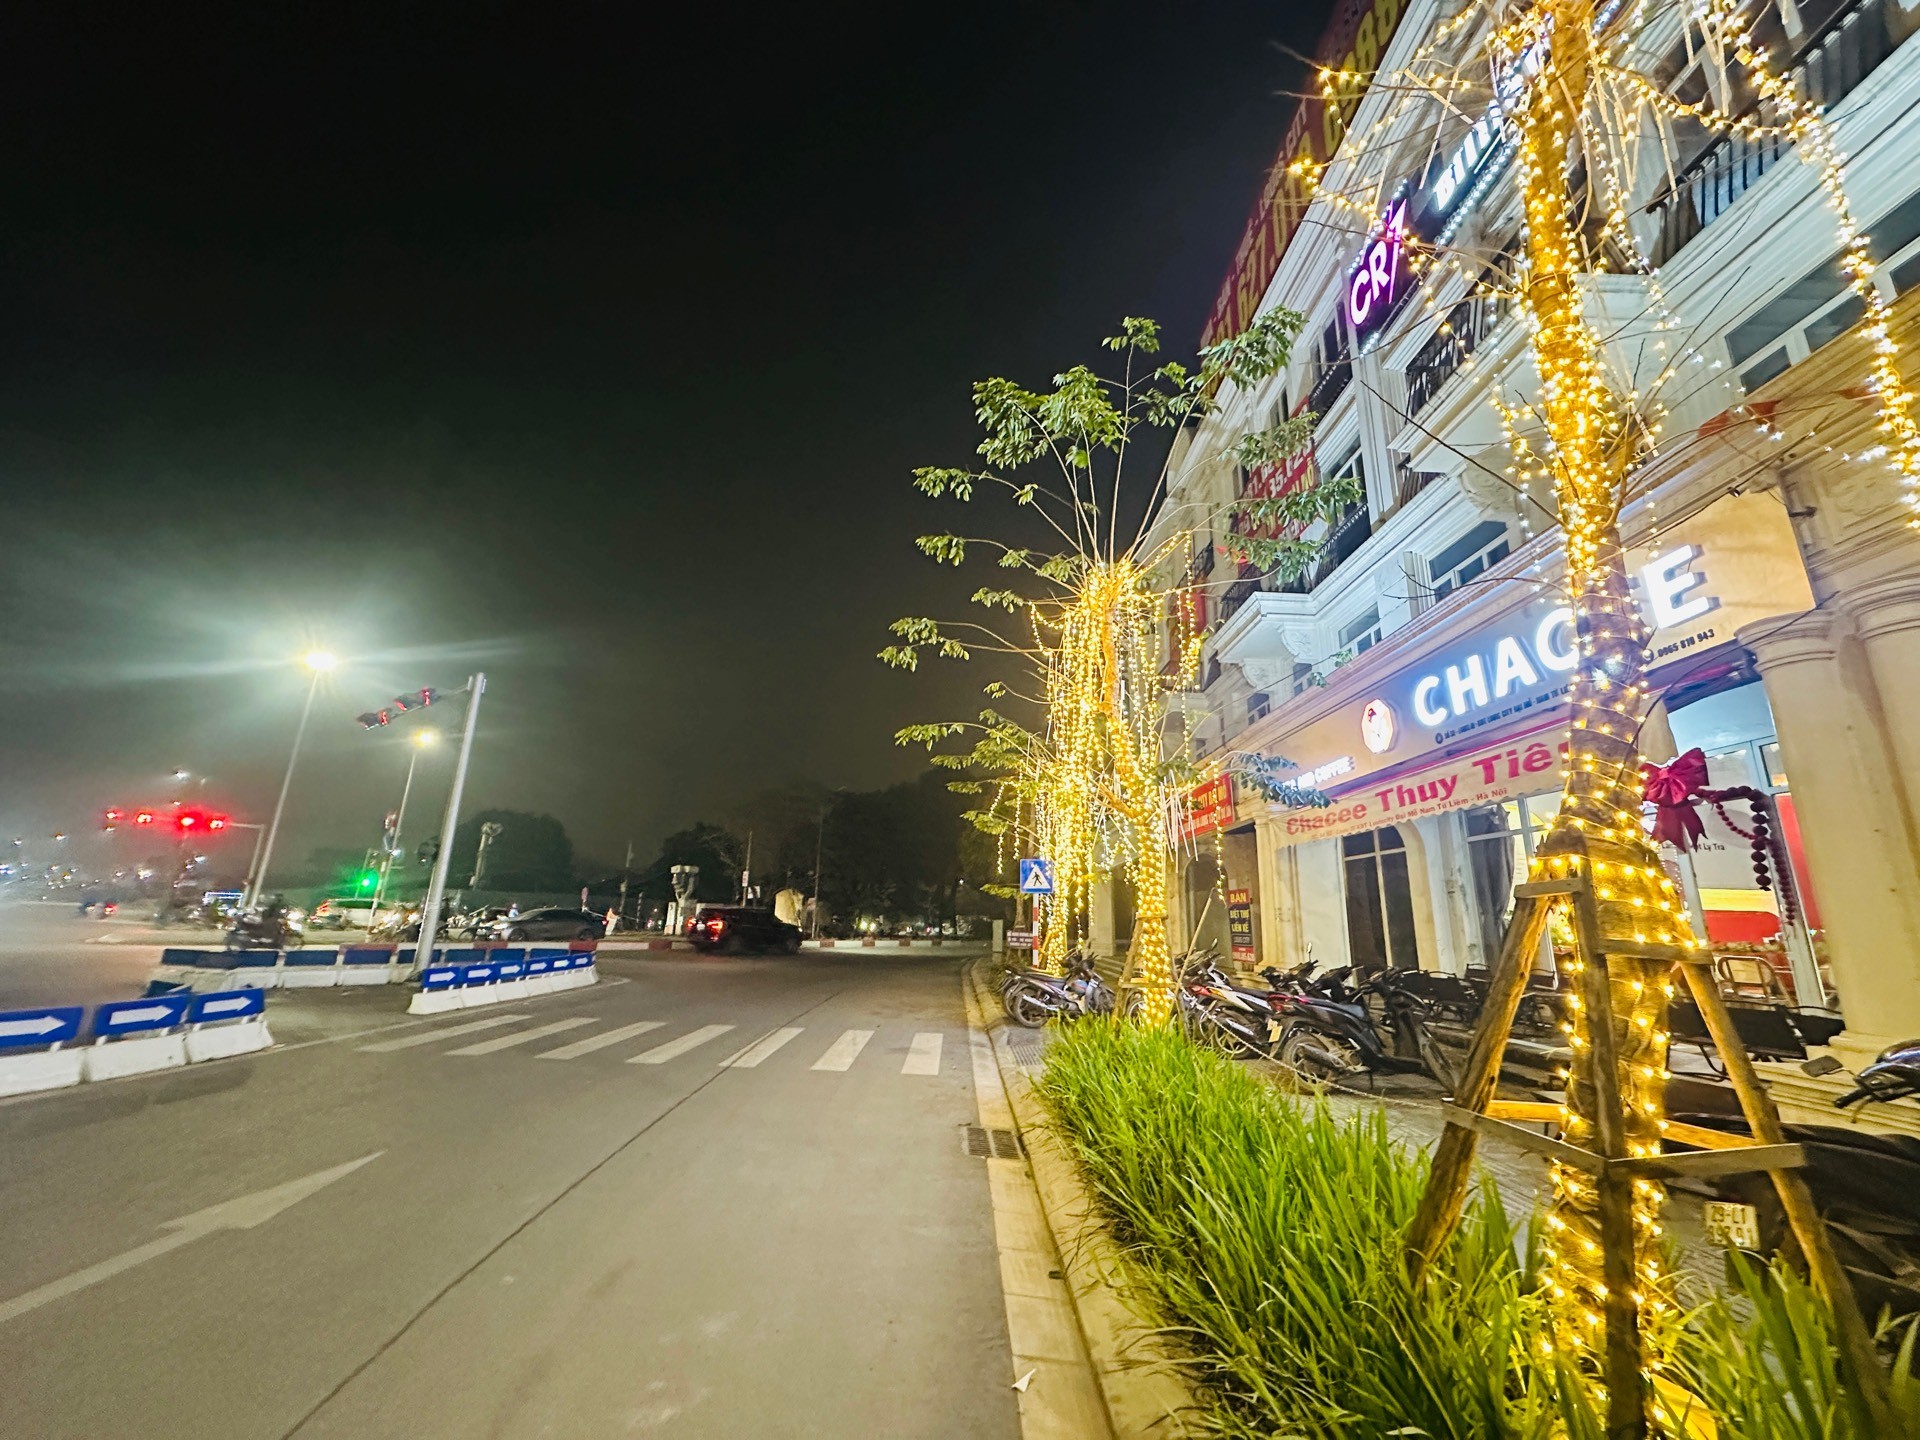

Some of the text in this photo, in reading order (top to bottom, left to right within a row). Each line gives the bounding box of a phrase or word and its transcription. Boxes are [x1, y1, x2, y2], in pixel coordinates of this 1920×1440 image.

[1413, 545, 1724, 727] CHACE
[1286, 740, 1570, 836] Chacee Thuy Tiê
